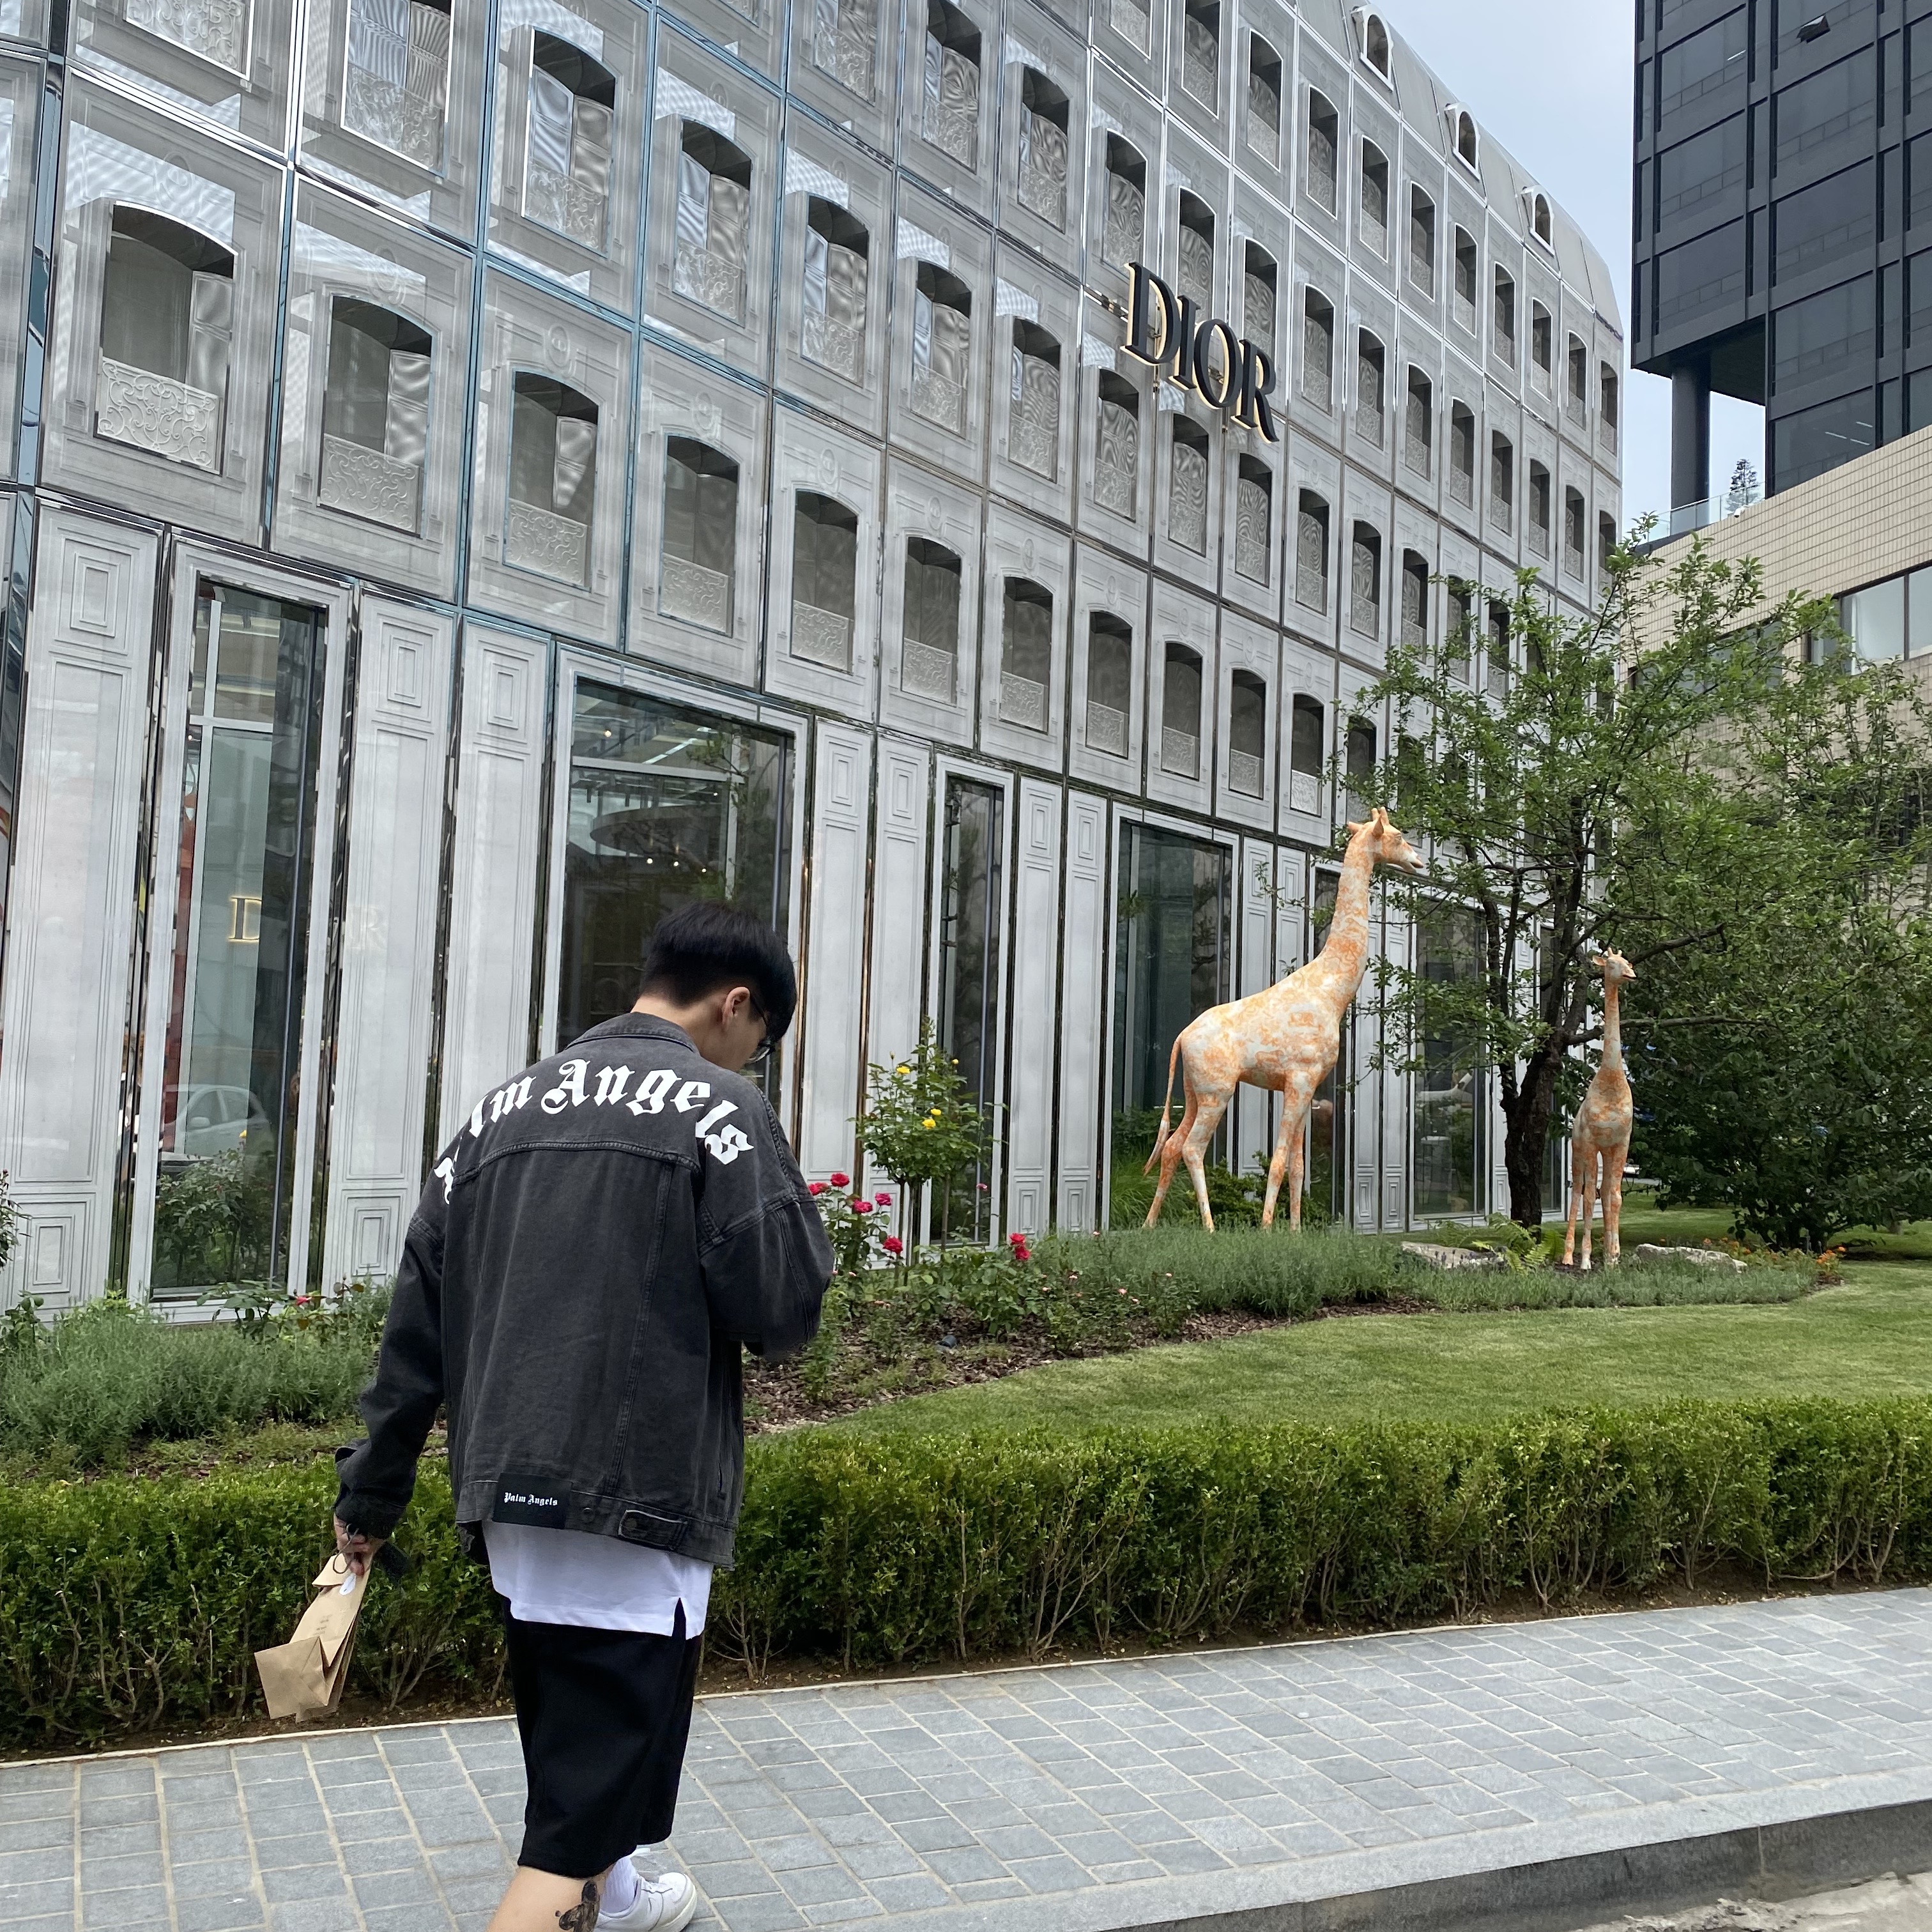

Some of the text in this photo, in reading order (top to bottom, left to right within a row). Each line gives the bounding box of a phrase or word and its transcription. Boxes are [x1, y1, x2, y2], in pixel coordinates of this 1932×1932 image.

[1120, 261, 1280, 443] DIOR
[541, 1059, 755, 1165] Angels
[503, 1492, 558, 1506] Palm Angels
